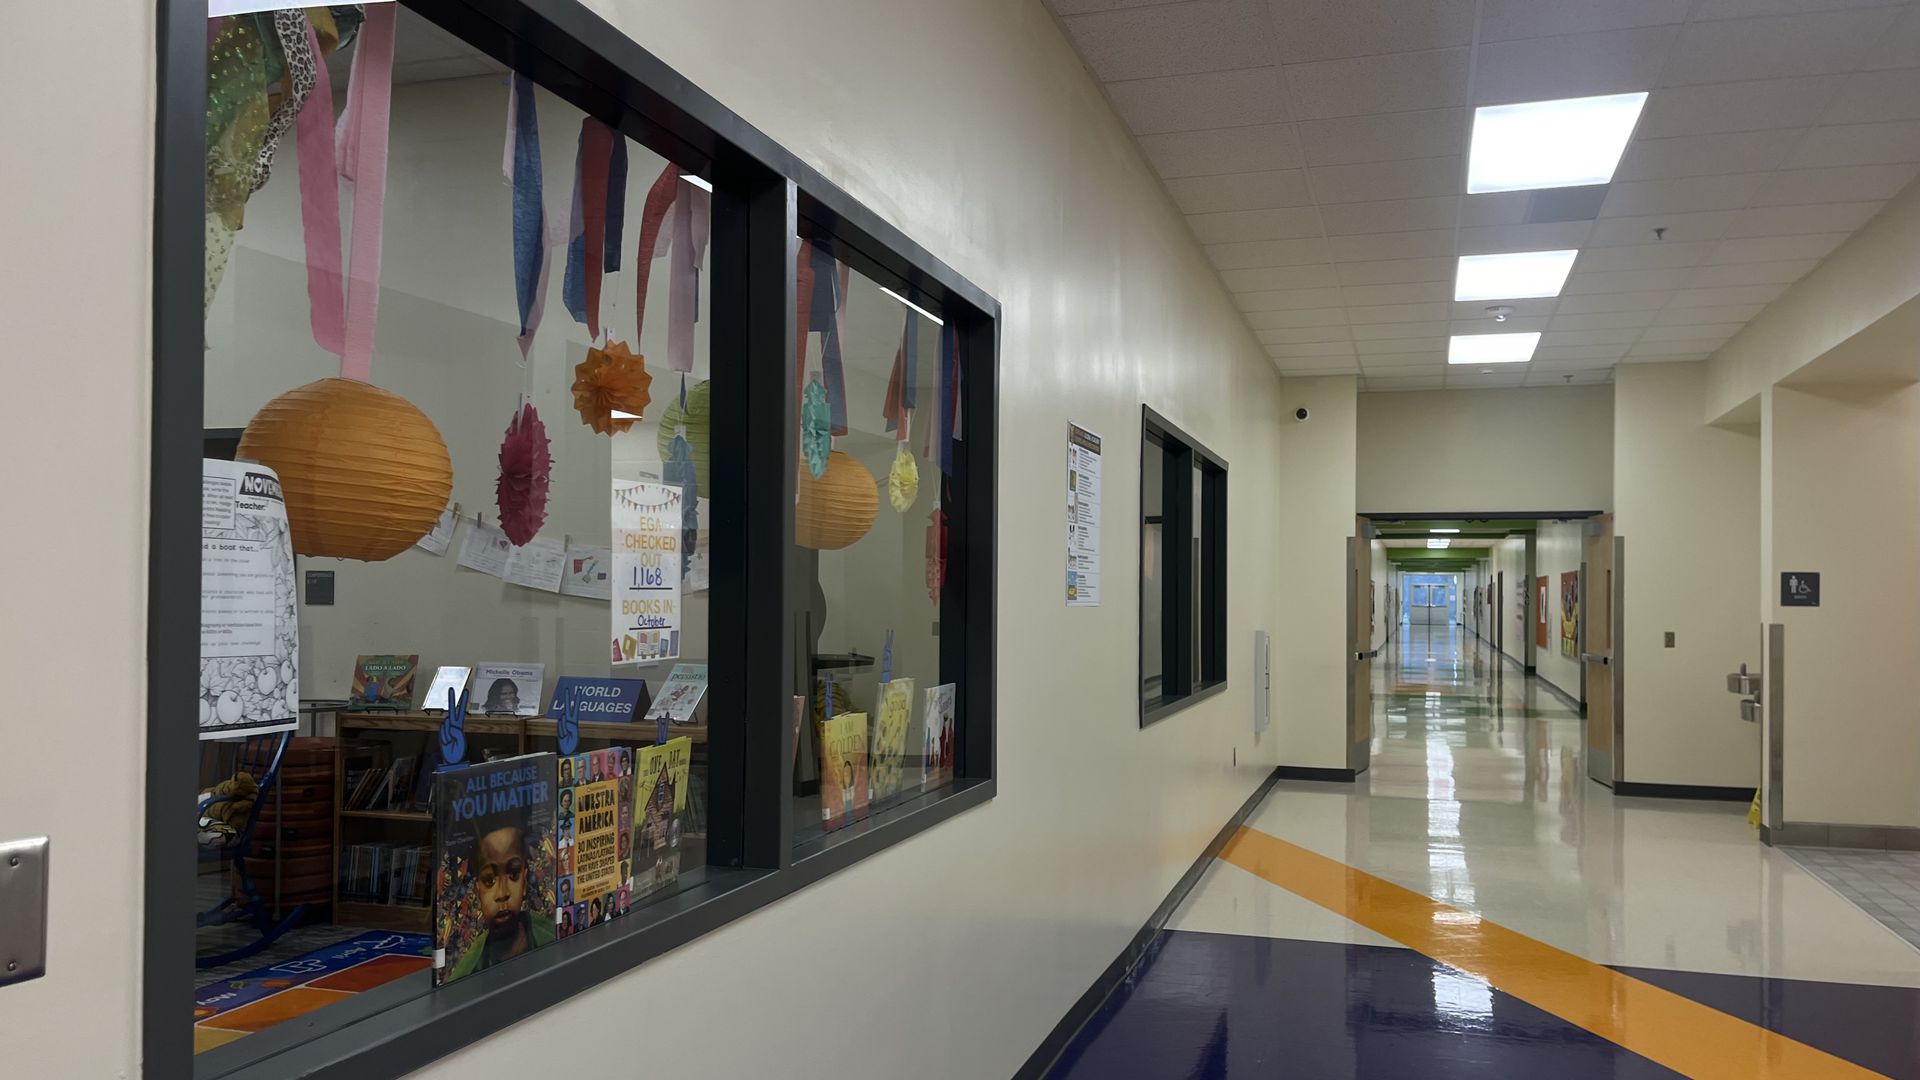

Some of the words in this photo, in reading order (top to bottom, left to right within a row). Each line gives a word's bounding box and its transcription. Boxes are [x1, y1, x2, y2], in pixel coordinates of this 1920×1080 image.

[639, 516, 662, 532] EGA
[625, 533, 676, 551] CHECKED
[640, 553, 662, 567] OUT
[622, 600, 660, 615] BOOKS
[663, 600, 673, 614] IN
[637, 614, 665, 628] October
[552, 700, 632, 714] LGUAGES
[466, 776, 487, 793] ALL
[490, 766, 537, 789] BECAUSE
[452, 793, 487, 822] YOU
[491, 781, 549, 814] MATTER
[578, 789, 615, 812] NUESTRA
[586, 832, 615, 852] INSPIRING
